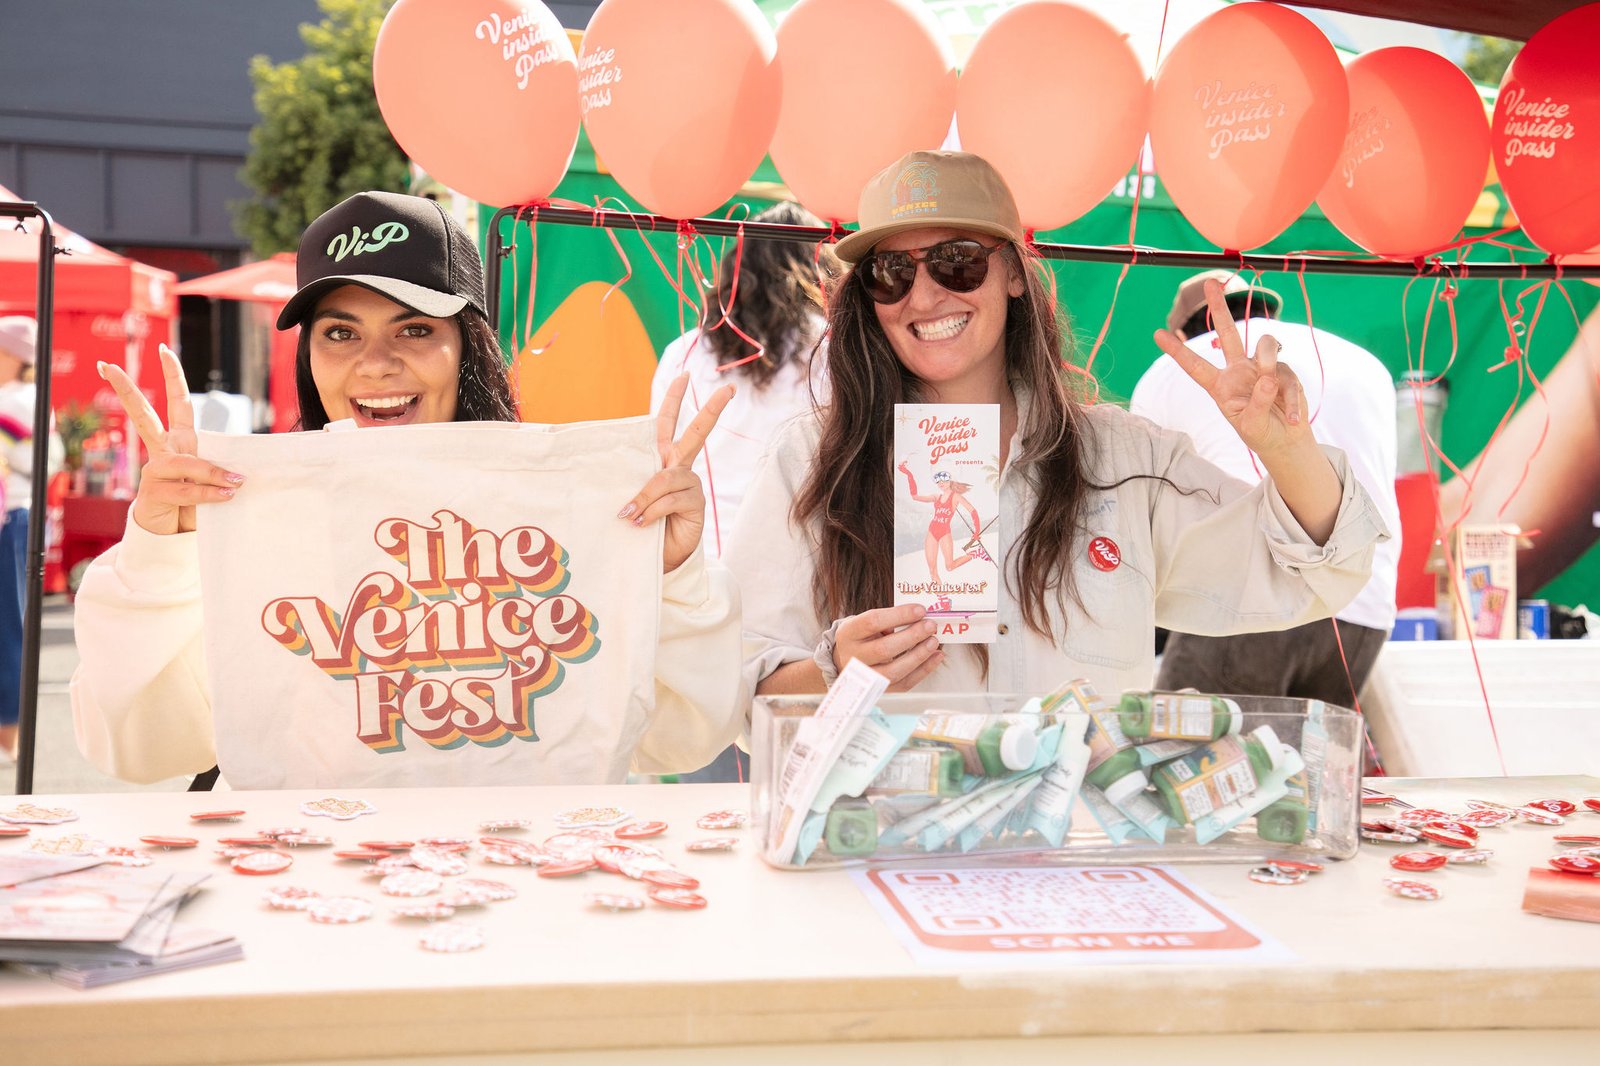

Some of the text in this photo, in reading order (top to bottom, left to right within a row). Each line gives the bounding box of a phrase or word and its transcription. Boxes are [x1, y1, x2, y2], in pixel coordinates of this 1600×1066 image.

[578, 63, 623, 94] nsider
[1194, 79, 1278, 111] Venice
[1503, 87, 1570, 119] Venice
[1204, 100, 1287, 129] insider
[1504, 116, 1575, 139] insider
[1208, 122, 1271, 160] Pass
[1505, 138, 1556, 167] Pass
[326, 221, 410, 263] ViP
[918, 415, 971, 435] Venice
[927, 427, 978, 447] insider
[929, 441, 969, 465] Pass
[374, 509, 568, 597] The
[1095, 540, 1120, 565] ViP
[261, 570, 600, 679] Venice
[935, 622, 970, 635] AP
[354, 646, 562, 752] Fest
[989, 935, 1196, 949] SCAN ME
